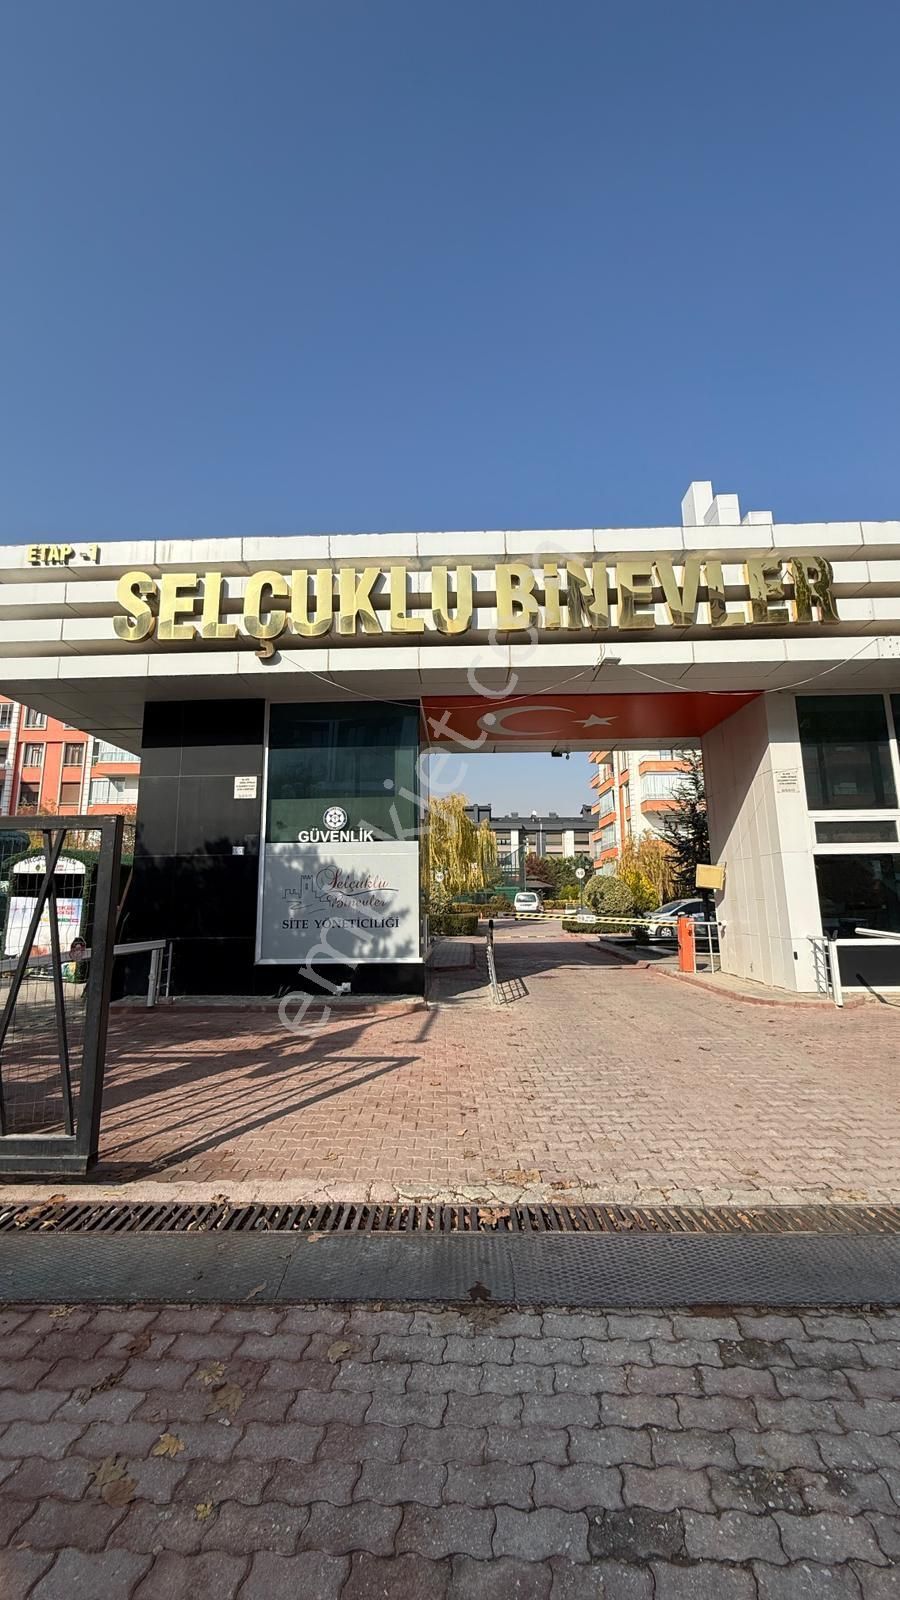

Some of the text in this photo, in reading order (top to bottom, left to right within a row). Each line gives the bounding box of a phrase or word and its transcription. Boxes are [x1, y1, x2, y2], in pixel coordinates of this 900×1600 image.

[27, 543, 74, 563] ETAP
[113, 565, 473, 658] SELÇUKLU
[298, 827, 374, 843] GÜVENLİK
[281, 915, 400, 929] SİTE YÖNETİCİLİĞİ
